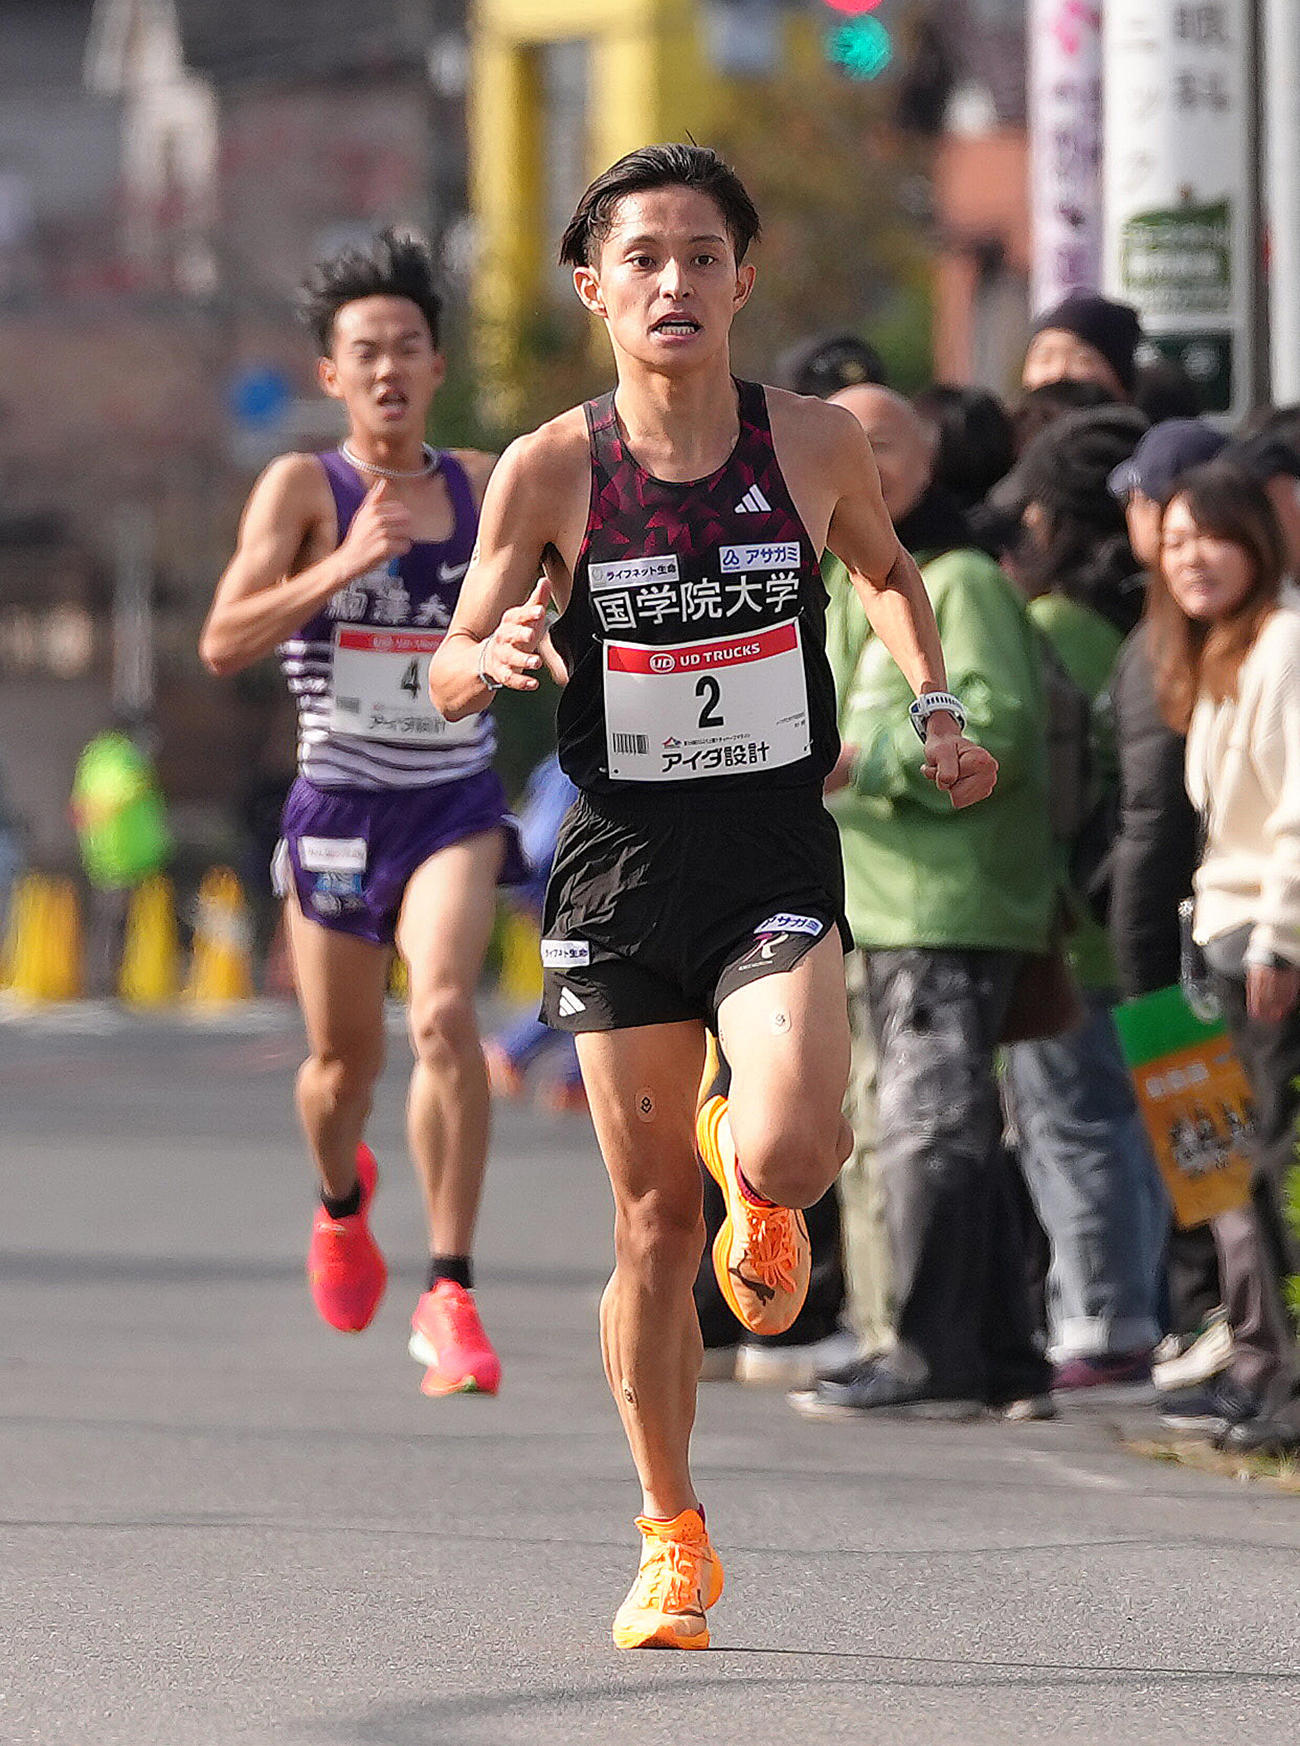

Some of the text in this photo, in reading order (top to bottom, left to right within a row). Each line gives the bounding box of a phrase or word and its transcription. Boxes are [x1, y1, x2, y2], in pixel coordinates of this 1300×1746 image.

[745, 546, 798, 565] アサガミ
[606, 564, 677, 581] ライフネット生命
[593, 571, 800, 632] 国学院大学
[680, 654, 700, 667] UD
[703, 642, 761, 663] TRUCKS
[400, 659, 421, 700] 4
[695, 675, 724, 729] 2
[662, 741, 770, 773] アイダ設計
